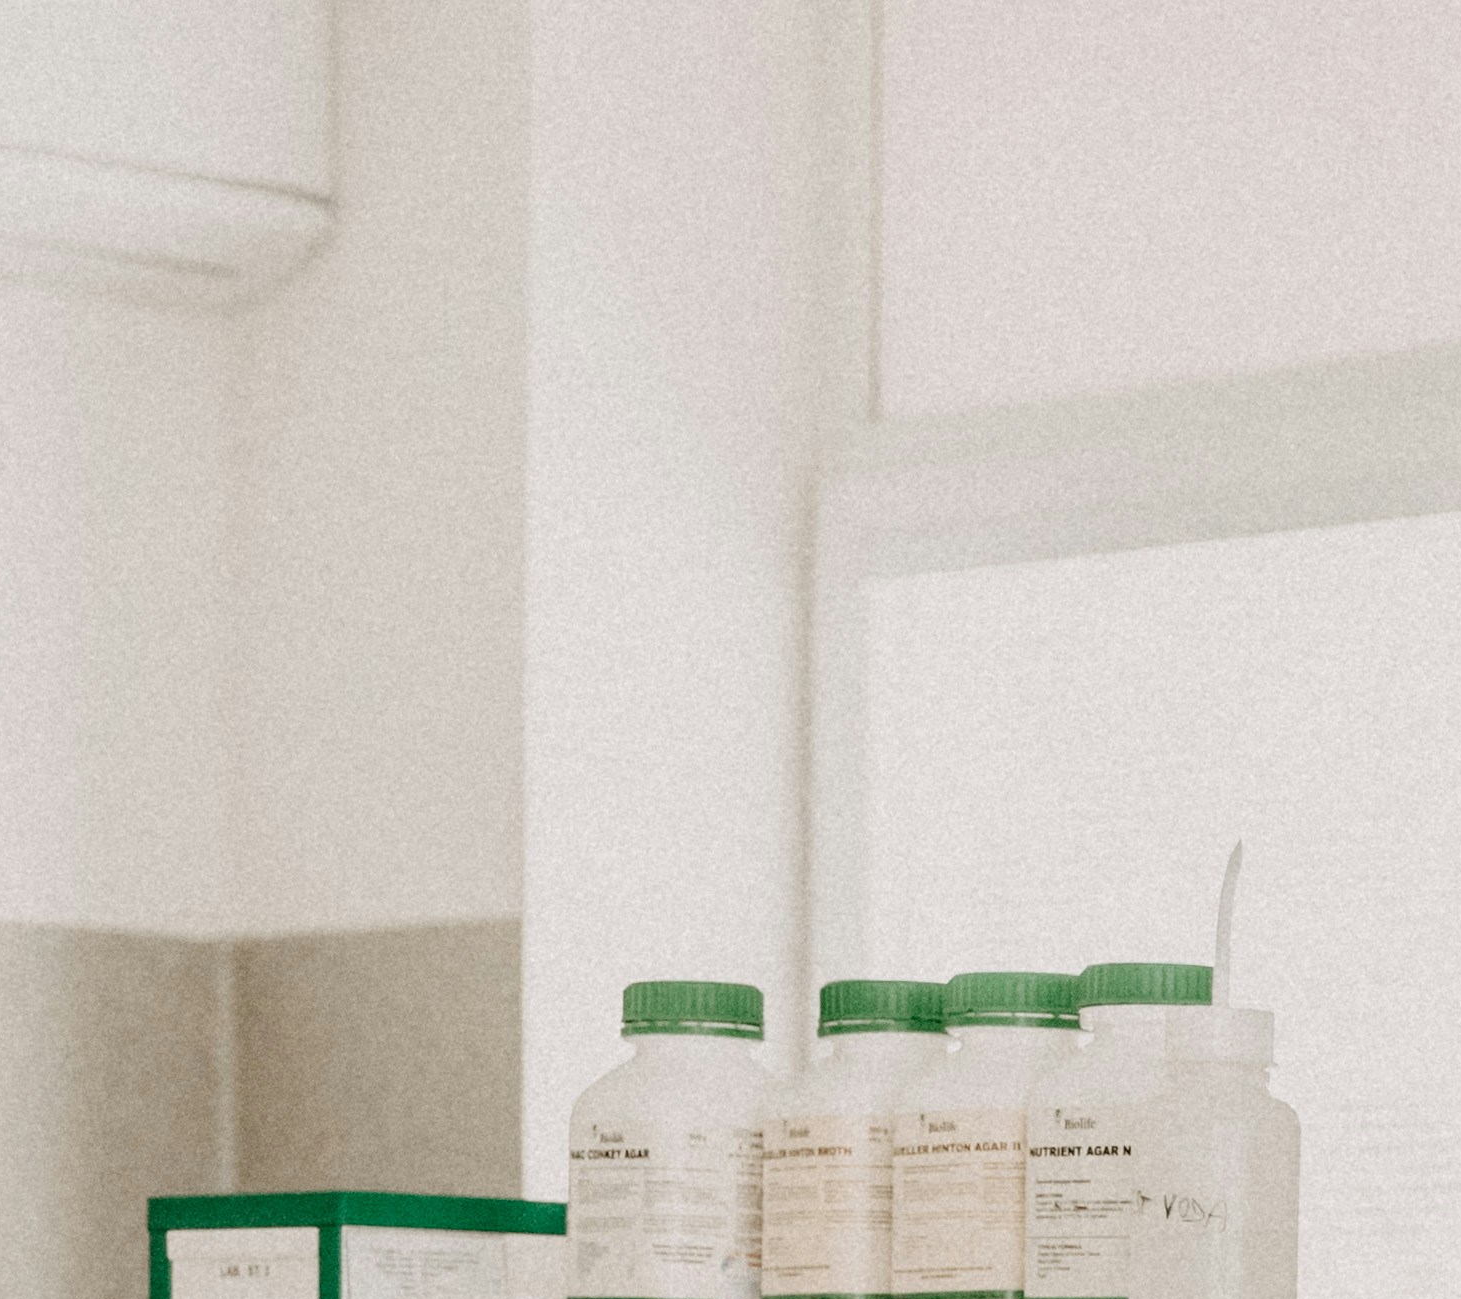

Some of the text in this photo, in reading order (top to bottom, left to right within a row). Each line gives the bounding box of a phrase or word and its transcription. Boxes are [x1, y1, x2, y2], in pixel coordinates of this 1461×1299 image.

[1064, 1118, 1096, 1130] Biolife
[625, 1148, 649, 1159] AGAR
[818, 1146, 853, 1157] BROTH
[932, 1143, 972, 1154] HINTON
[975, 1142, 1008, 1153] AGAR
[1029, 1145, 1132, 1158] NUTRIENT AGAR N
